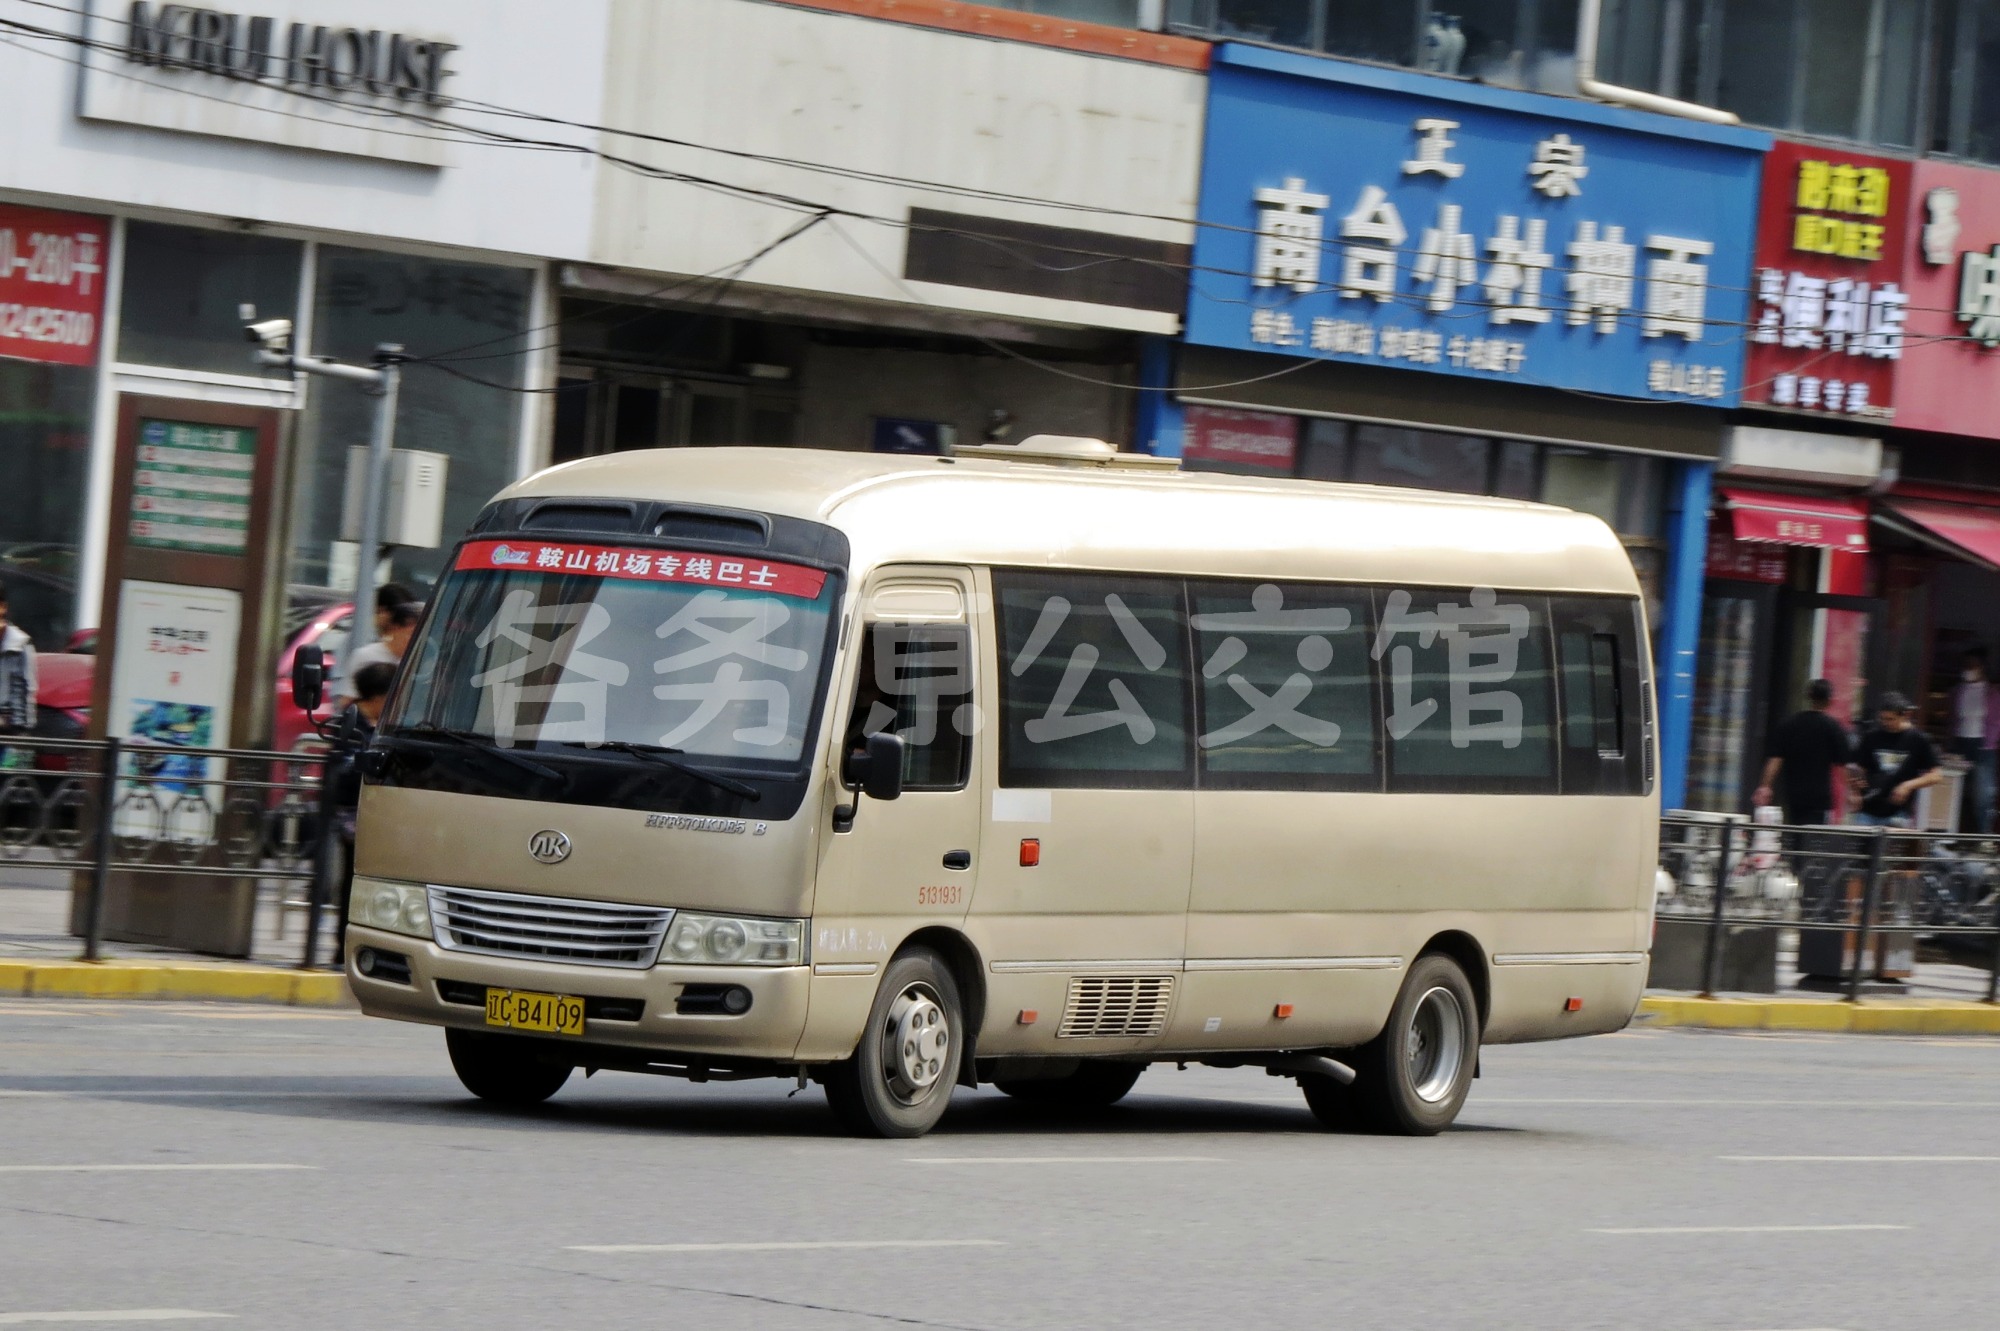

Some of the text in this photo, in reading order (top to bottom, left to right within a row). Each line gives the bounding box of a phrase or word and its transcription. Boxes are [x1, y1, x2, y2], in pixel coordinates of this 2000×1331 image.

[287, 22, 461, 106] HOUSE
[1781, 271, 1909, 359] 便利店
[536, 546, 778, 587] 鞍山机场专线巴士
[752, 822, 768, 836] B
[918, 886, 962, 905] 5131931
